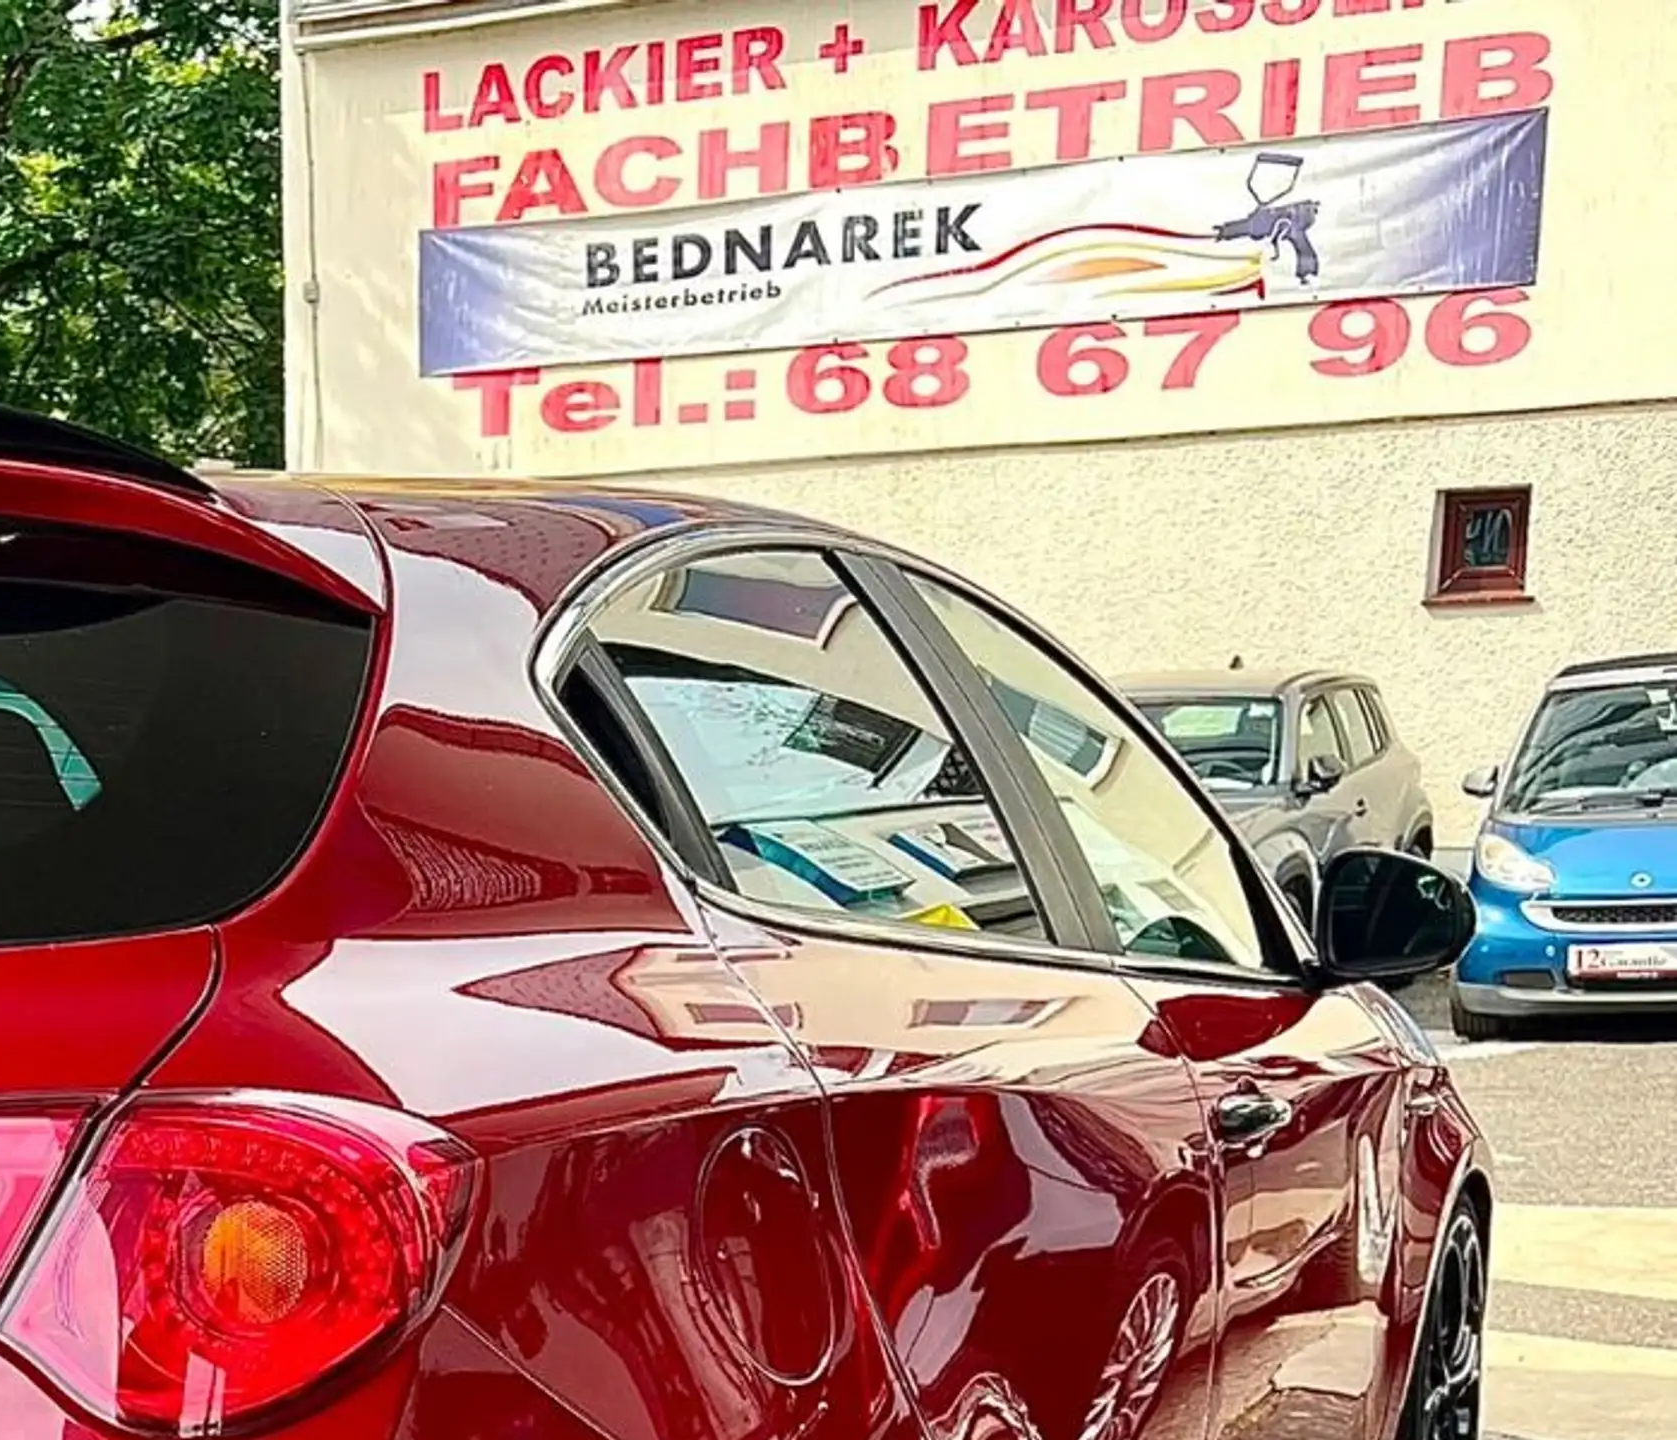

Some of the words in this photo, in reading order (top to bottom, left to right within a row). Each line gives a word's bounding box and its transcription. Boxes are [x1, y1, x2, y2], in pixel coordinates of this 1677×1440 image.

[423, 26, 786, 133] LACKIER
[820, 25, 864, 73] +
[433, 32, 1554, 230] FACHBETRIEB
[582, 283, 782, 317] Meisterbetrieb
[586, 203, 983, 289] BEDNAREK
[452, 358, 756, 438] Tel.:
[786, 335, 970, 414] 68
[1036, 311, 1241, 397] 67
[1308, 287, 1531, 377] 96
